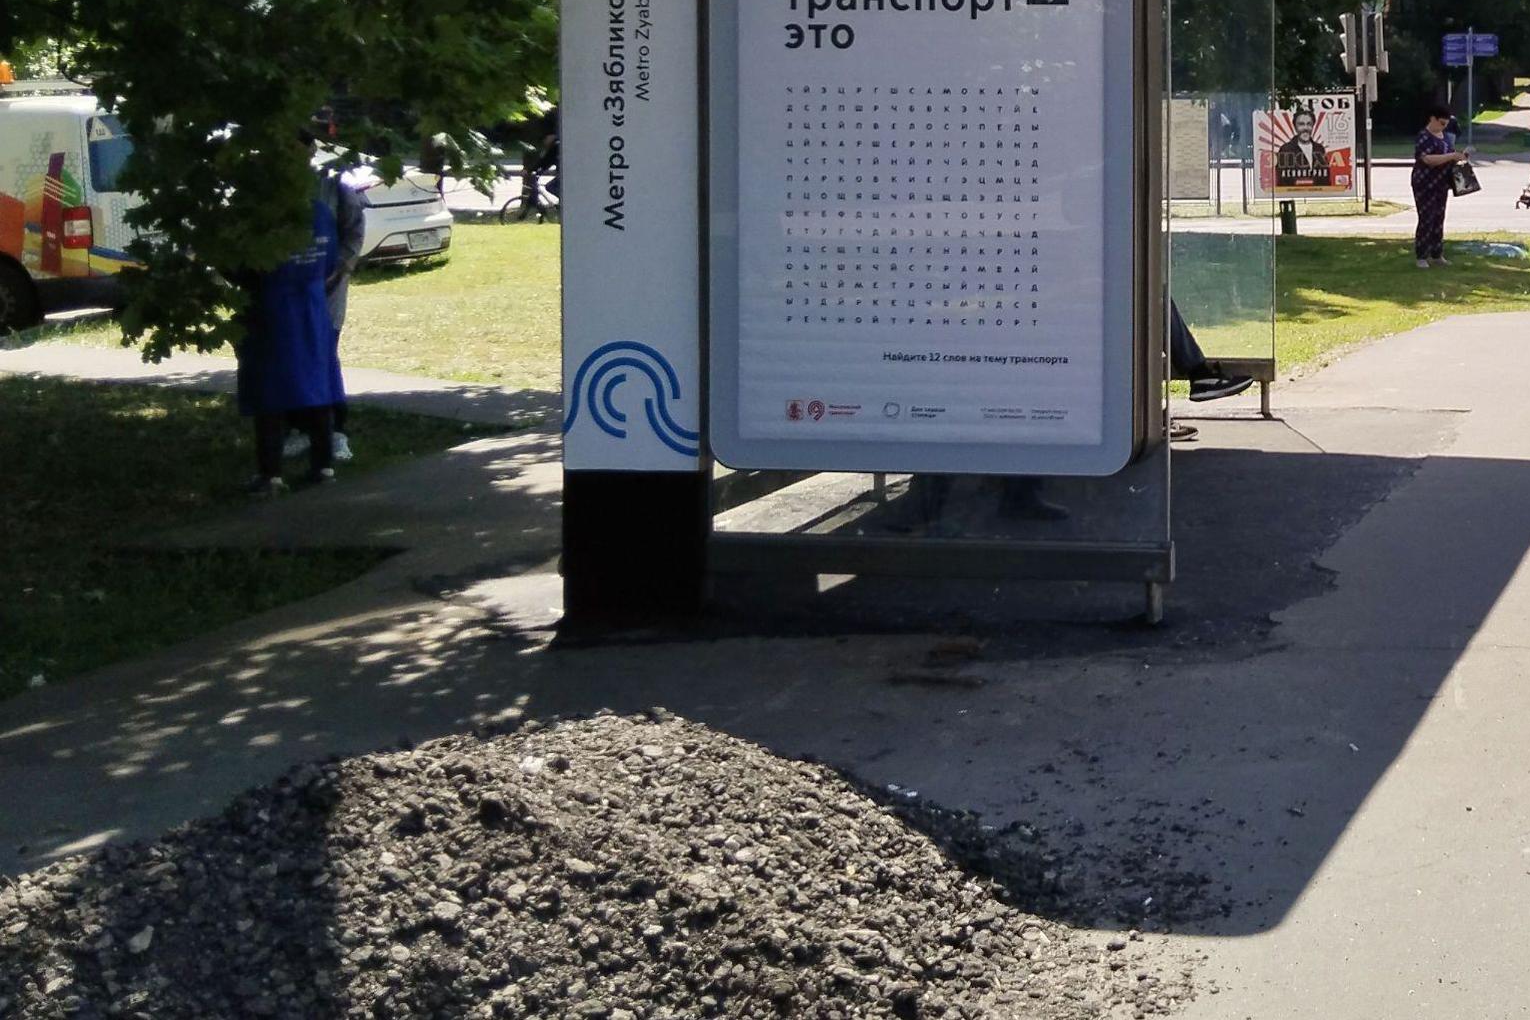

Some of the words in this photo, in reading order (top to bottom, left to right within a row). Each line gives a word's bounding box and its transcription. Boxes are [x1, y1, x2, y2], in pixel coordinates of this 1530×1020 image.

[784, 23, 855, 49] это
[635, 45, 650, 102] Metro
[604, 135, 629, 231] Метро
[881, 352, 927, 364] Найдите
[929, 352, 941, 363] 12
[943, 354, 967, 364] слов
[969, 355, 982, 364] на
[983, 355, 1008, 366] тему
[1010, 356, 1070, 367] транспорта
